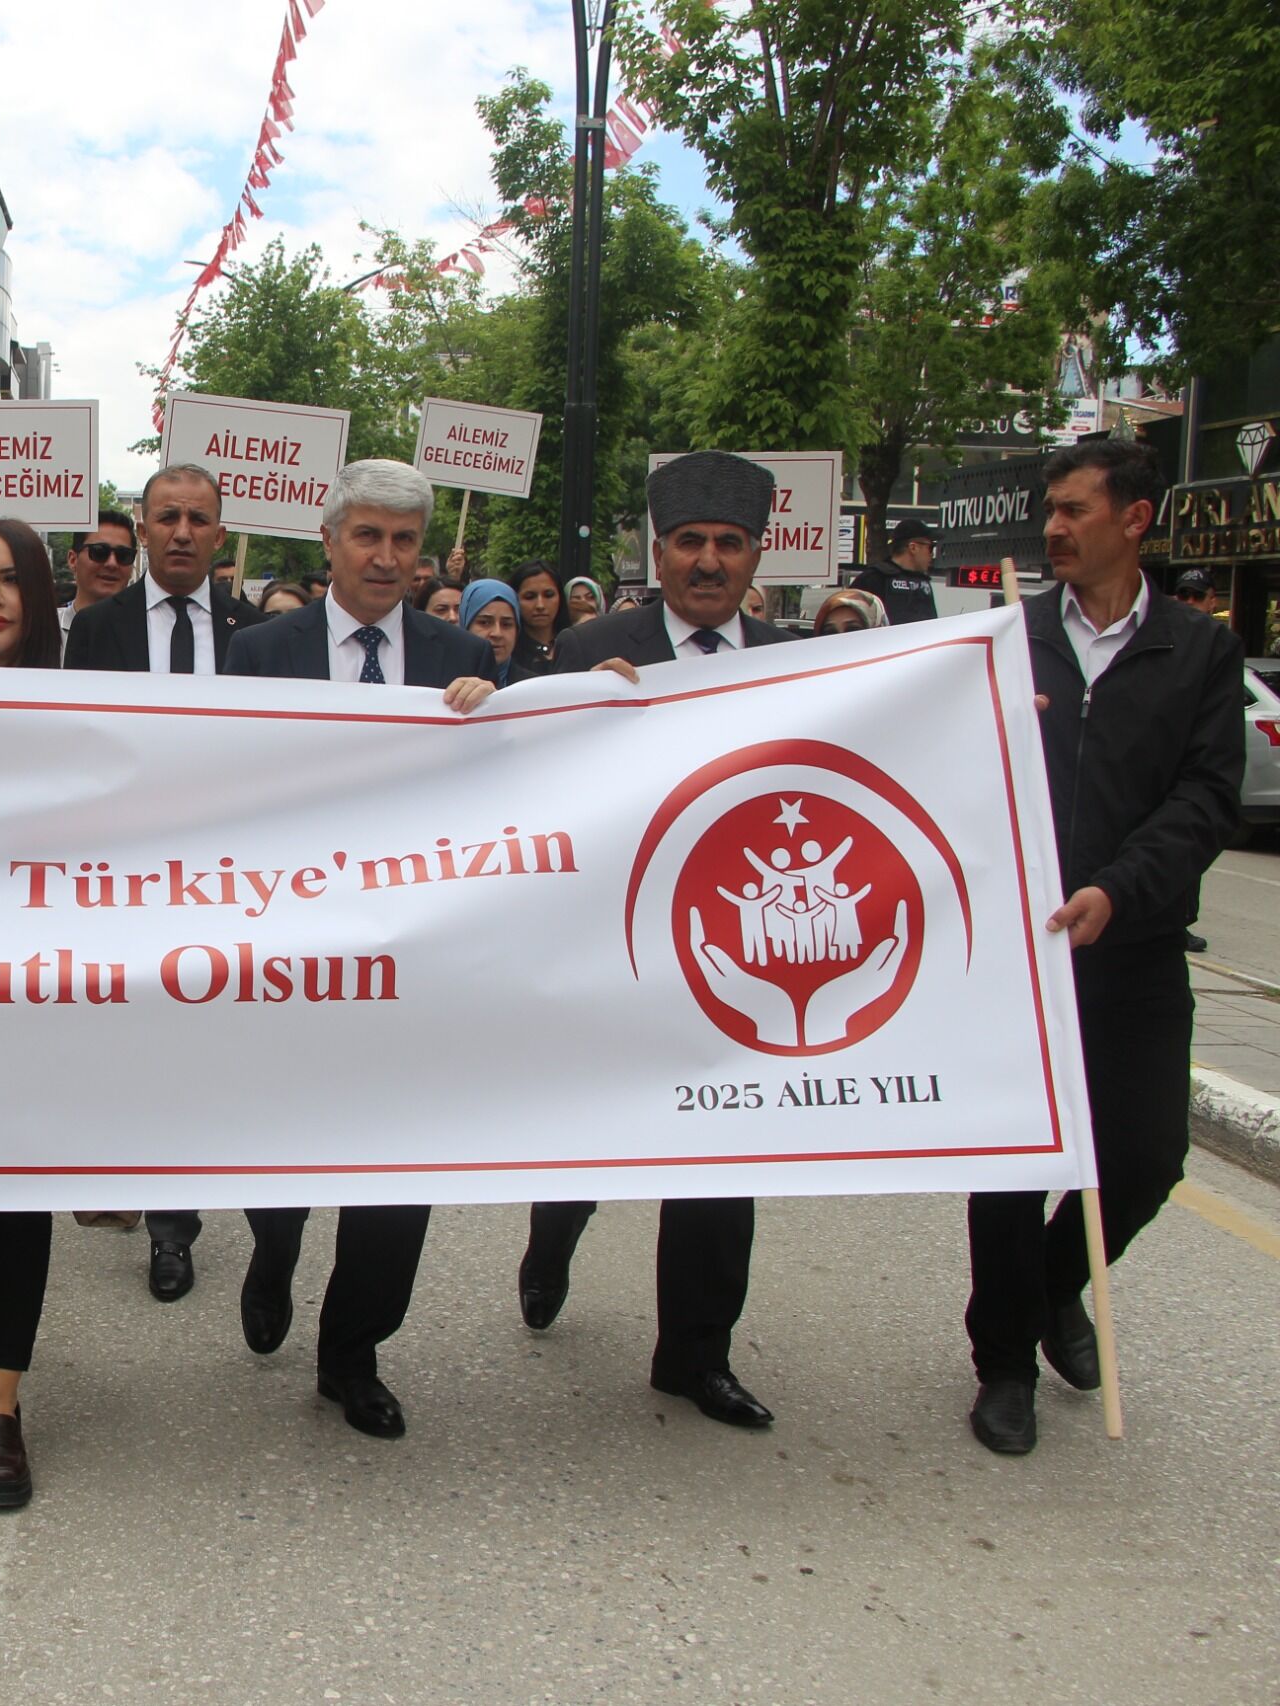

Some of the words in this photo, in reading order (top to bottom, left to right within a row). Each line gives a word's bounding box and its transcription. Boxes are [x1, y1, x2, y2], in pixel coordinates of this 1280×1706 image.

[205, 429, 302, 466] AİLEMİZ
[447, 422, 509, 449] AİLEMİZ
[424, 446, 525, 476] GELECEĞİMİZ
[218, 471, 329, 507] ECEĞİMİZ
[940, 497, 982, 529] TUTKU
[985, 486, 1030, 524] DÖVİZ
[9, 825, 581, 918] Türkiye'mizin
[159, 942, 400, 1004] Olsun
[675, 1082, 764, 1112] 2025
[777, 1071, 860, 1108] AİLE
[869, 1074, 943, 1105] YILI
